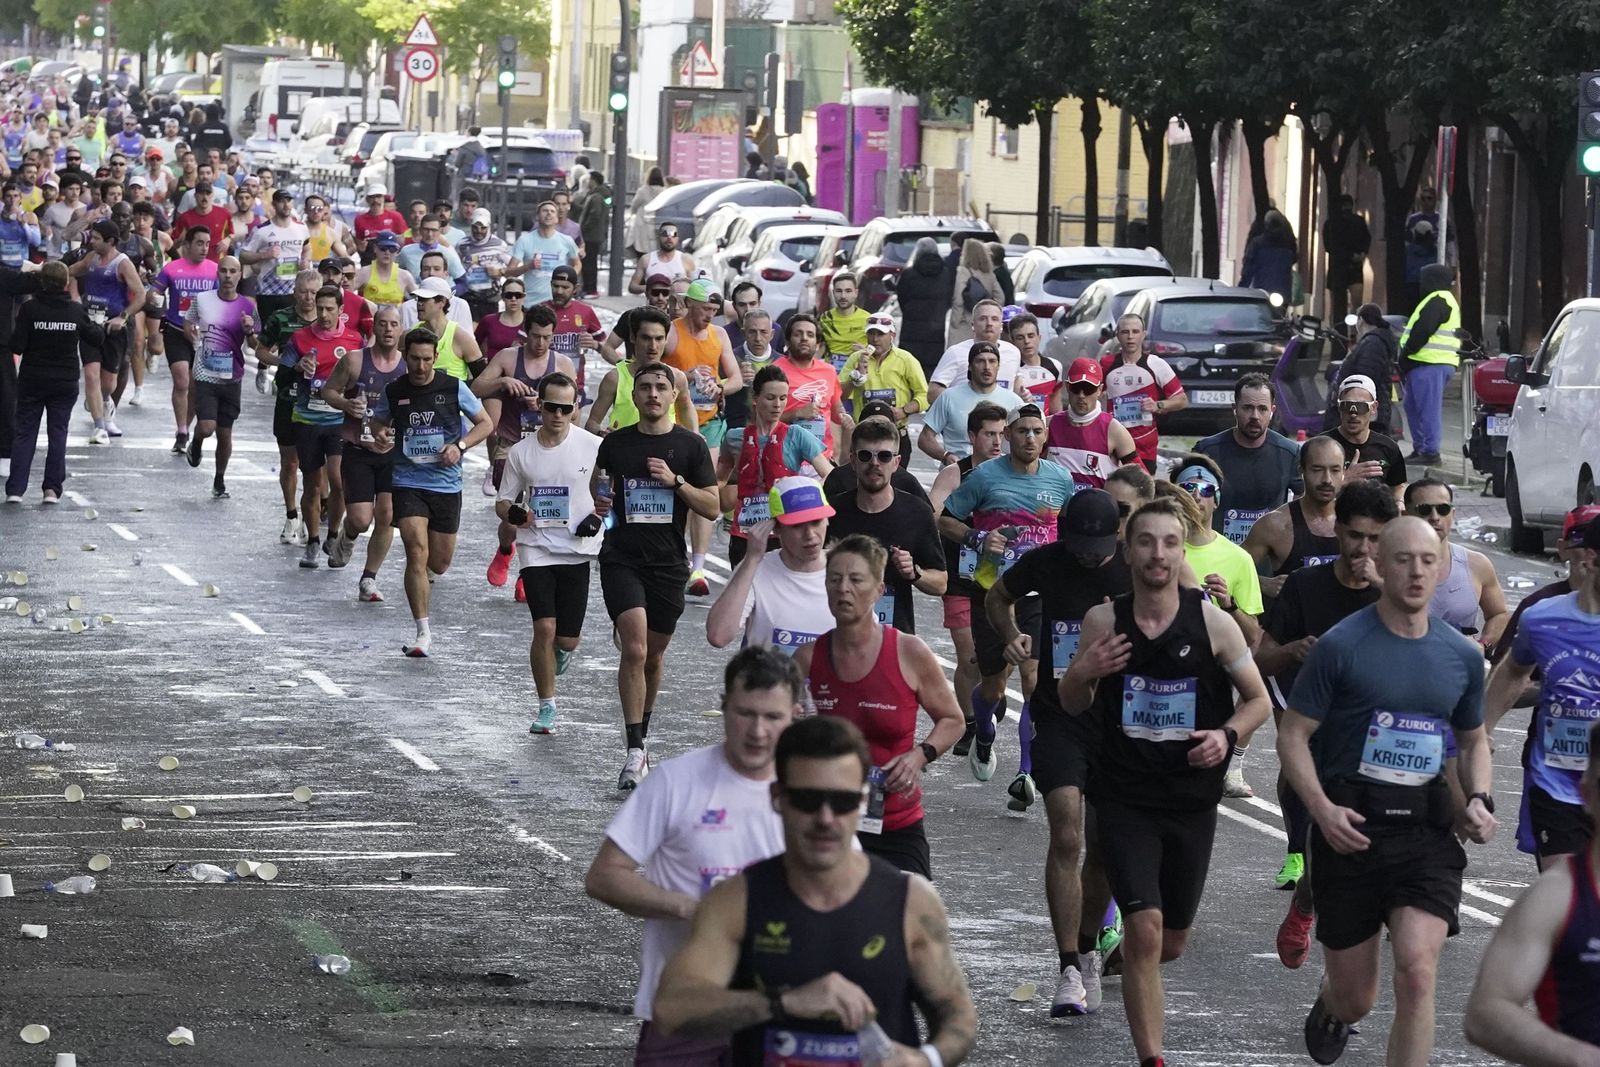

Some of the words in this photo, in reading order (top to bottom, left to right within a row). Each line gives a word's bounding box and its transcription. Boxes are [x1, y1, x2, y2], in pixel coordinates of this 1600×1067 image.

[411, 58, 432, 70] 30
[33, 321, 77, 331] VOLUNTEER
[1200, 390, 1227, 403] 4249
[640, 480, 665, 488] ZURIC
[537, 488, 564, 496] ZURICH
[630, 503, 666, 513] MARTIN
[1148, 682, 1187, 693] ZURICH
[1132, 711, 1185, 727] MAXIME
[1397, 718, 1435, 732] ZURICH
[1394, 738, 1416, 750] 5821
[1372, 748, 1432, 770] KRISTOF
